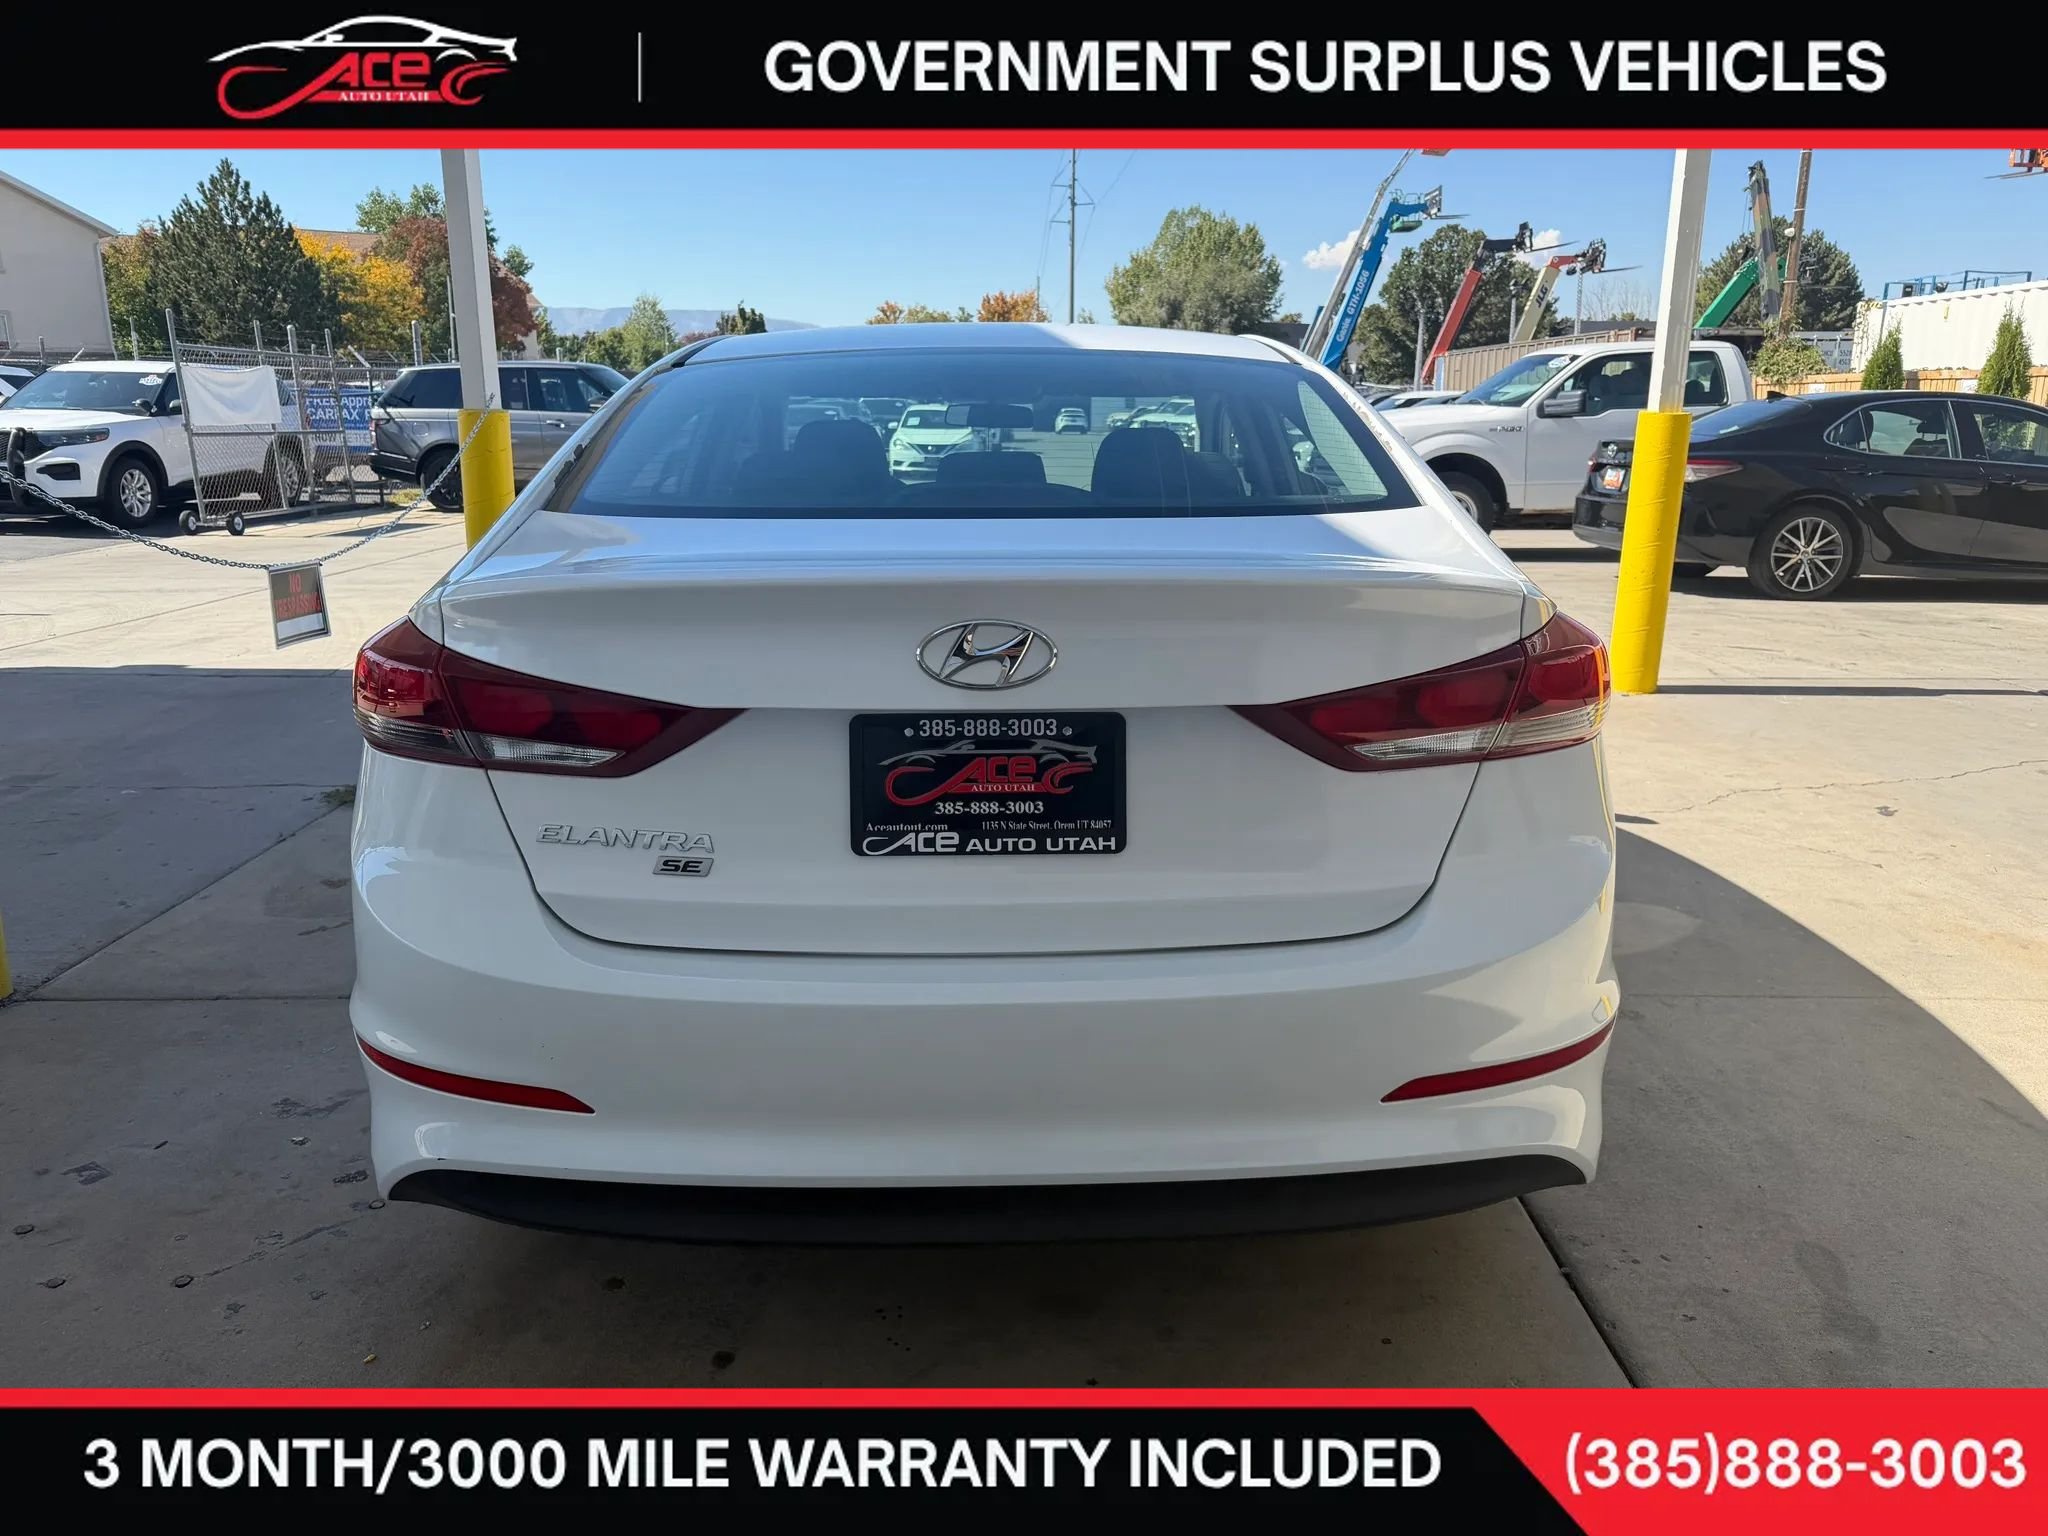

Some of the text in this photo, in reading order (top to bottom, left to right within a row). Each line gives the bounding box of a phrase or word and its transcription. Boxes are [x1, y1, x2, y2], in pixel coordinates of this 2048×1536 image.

[1536, 284, 1549, 308] JLG
[289, 573, 302, 593] NO
[919, 718, 1058, 737] 385-888-3003
[970, 783, 1035, 793] AUTO UTAH
[934, 801, 1045, 815] 385-888-3003
[981, 820, 999, 831] 1135
[1000, 820, 1007, 831] N
[1008, 820, 1027, 831] State
[1090, 819, 1112, 829] 84057
[536, 823, 715, 853] ELANTRA
[965, 837, 1037, 853] AUTO
[1046, 836, 1116, 852] UTAH
[659, 858, 704, 874] SE
